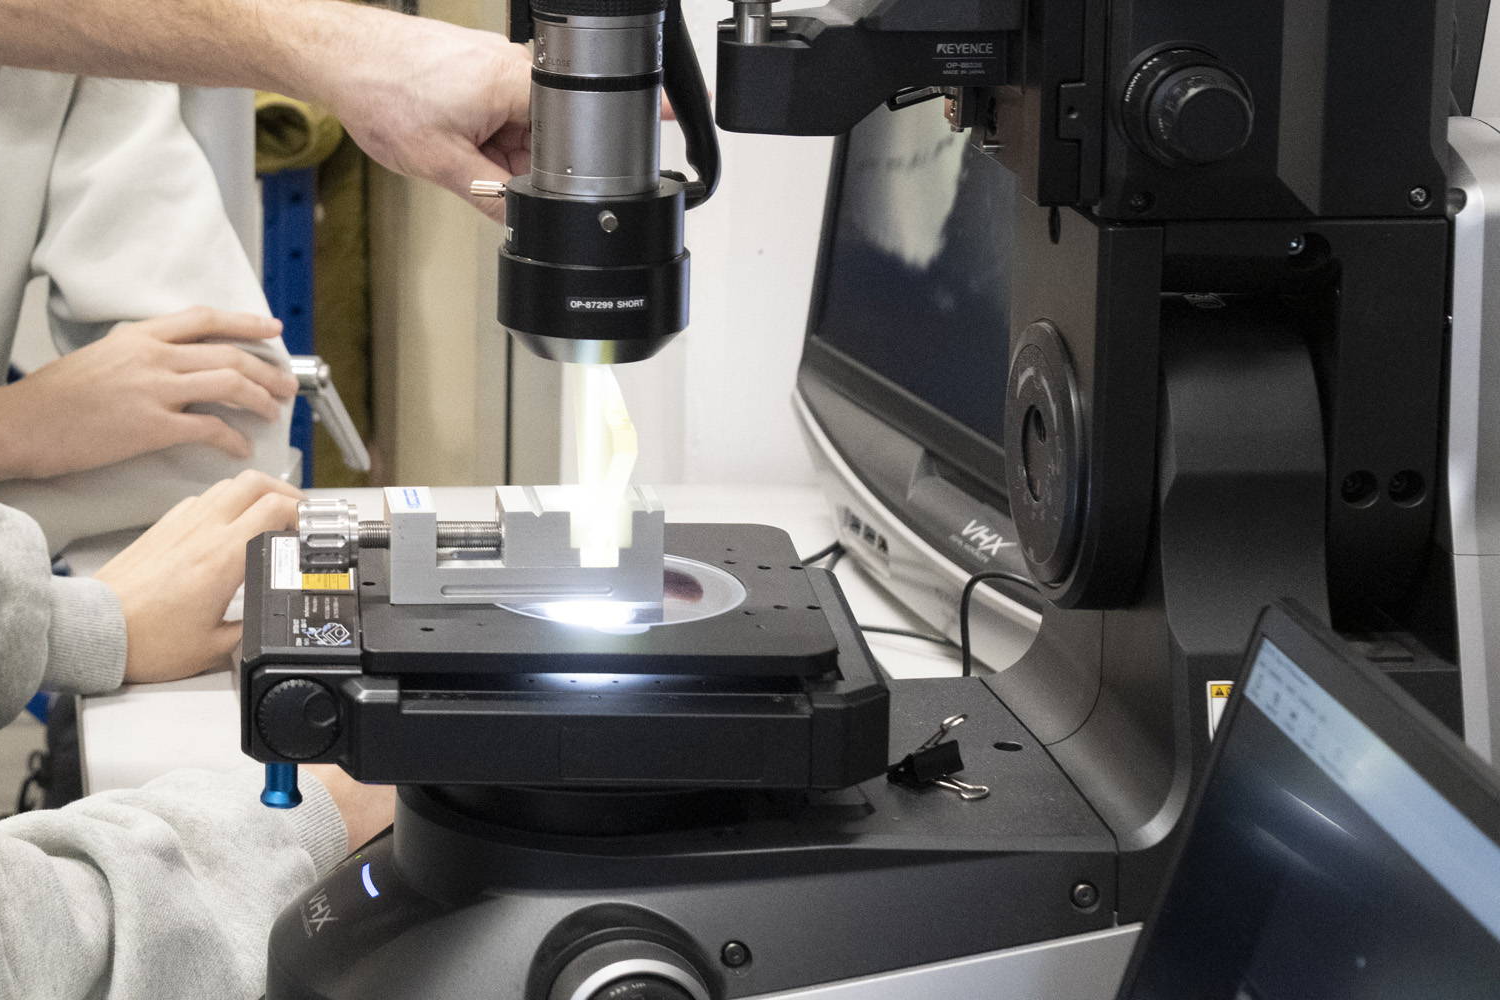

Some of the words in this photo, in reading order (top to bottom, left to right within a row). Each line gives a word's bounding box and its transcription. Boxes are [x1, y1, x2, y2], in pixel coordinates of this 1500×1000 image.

[936, 43, 993, 54] KEYENCE
[569, 300, 614, 309] OP-87299
[616, 299, 645, 309] SHORT
[961, 519, 1018, 557] VHX
[308, 887, 340, 932] VHX
